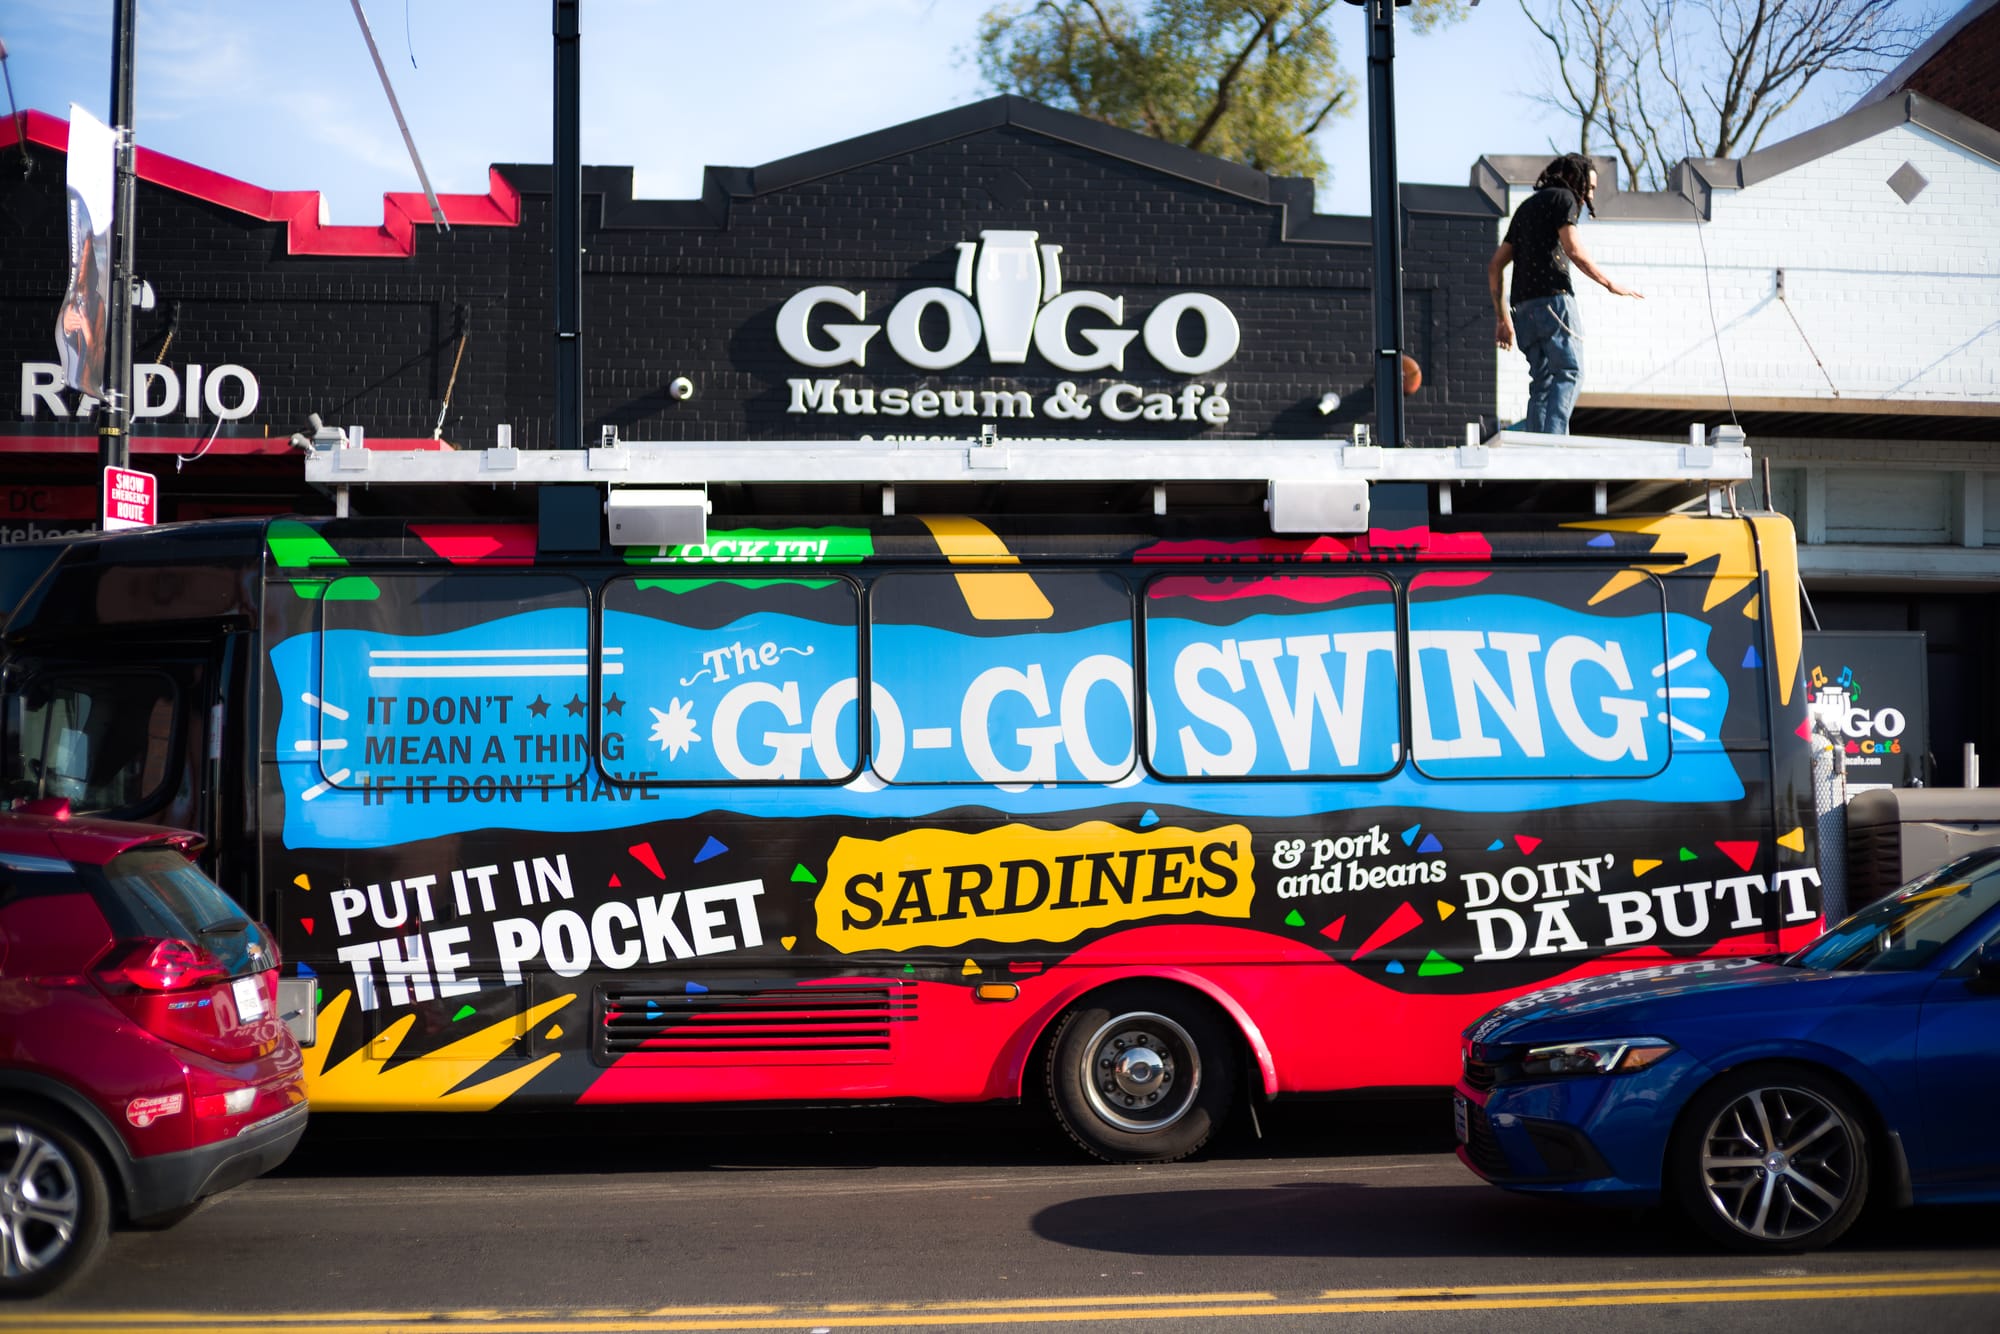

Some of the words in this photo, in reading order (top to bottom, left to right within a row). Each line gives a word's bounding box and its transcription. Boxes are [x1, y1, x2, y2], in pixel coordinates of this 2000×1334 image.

[775, 285, 983, 370] GO
[1034, 290, 1241, 375] GO
[786, 378, 1035, 419] Museum
[1042, 381, 1092, 420] &
[1100, 381, 1232, 425] Café
[9, 490, 48, 513] DC
[111, 488, 151, 505] EMERGENCY
[115, 473, 145, 493] SNOW
[117, 501, 145, 521] ROUTE
[768, 539, 828, 562] IT!
[702, 640, 781, 684] The
[366, 696, 395, 725] IT
[405, 695, 513, 725] DON'T
[711, 653, 1157, 793] GO-GO
[1173, 629, 1649, 777] SWING
[365, 735, 473, 765] MEAN
[481, 734, 505, 764] A
[513, 732, 626, 762] THING
[1861, 738, 1902, 754] Café
[362, 776, 399, 807] IF
[405, 775, 432, 805] IT
[447, 774, 557, 805] DON'T
[564, 771, 660, 803] HAVE
[1271, 839, 1306, 871] &
[1311, 825, 1392, 872] pork
[329, 874, 437, 936] PUT
[450, 864, 501, 916] IT
[512, 853, 575, 906] IN
[841, 840, 1240, 932] SARDINES
[1276, 863, 1343, 900] and
[1347, 859, 1447, 892] beans
[1459, 853, 1616, 909] DOIN'
[1466, 900, 1588, 963] DA
[1597, 867, 1823, 948] BUTT
[337, 926, 481, 1012] THE
[492, 878, 766, 987] POCKET
